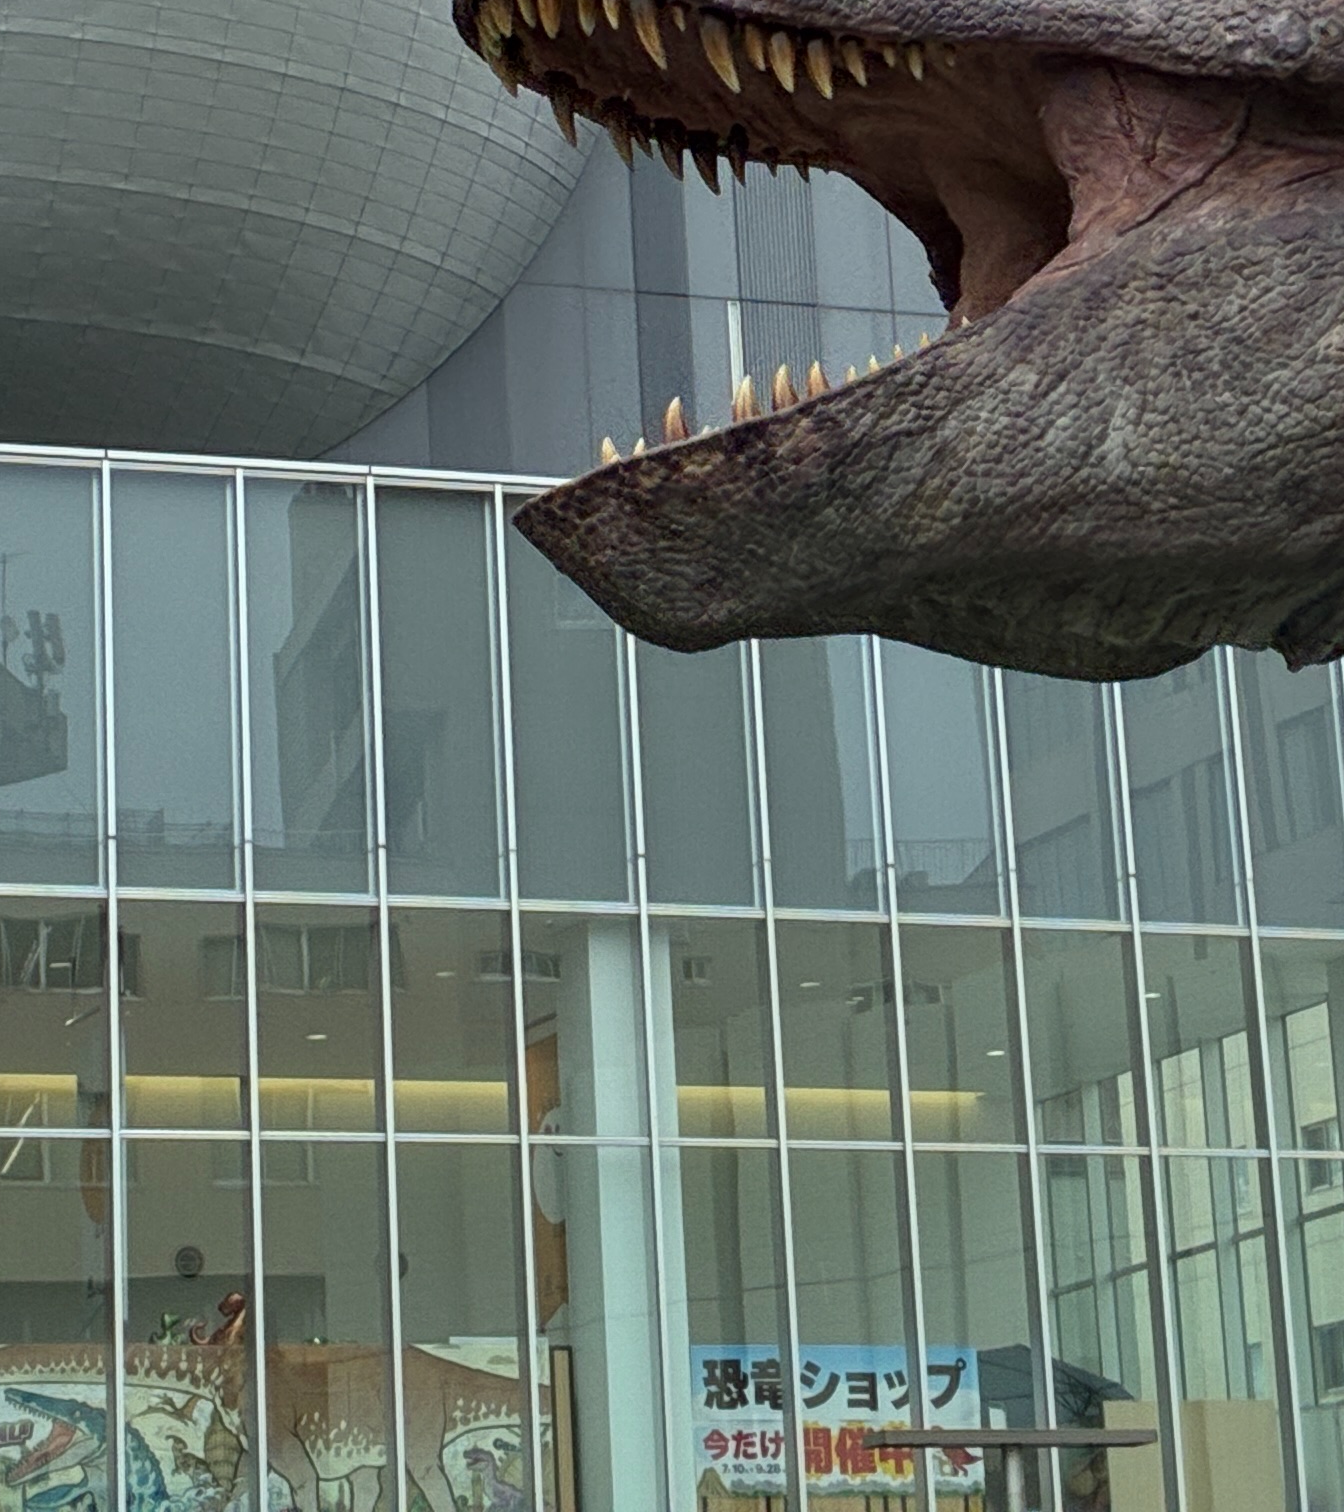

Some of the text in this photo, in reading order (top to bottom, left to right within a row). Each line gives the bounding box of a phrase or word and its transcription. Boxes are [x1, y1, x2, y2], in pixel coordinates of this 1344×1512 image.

[702, 1357, 967, 1410] 恐竜ショップ
